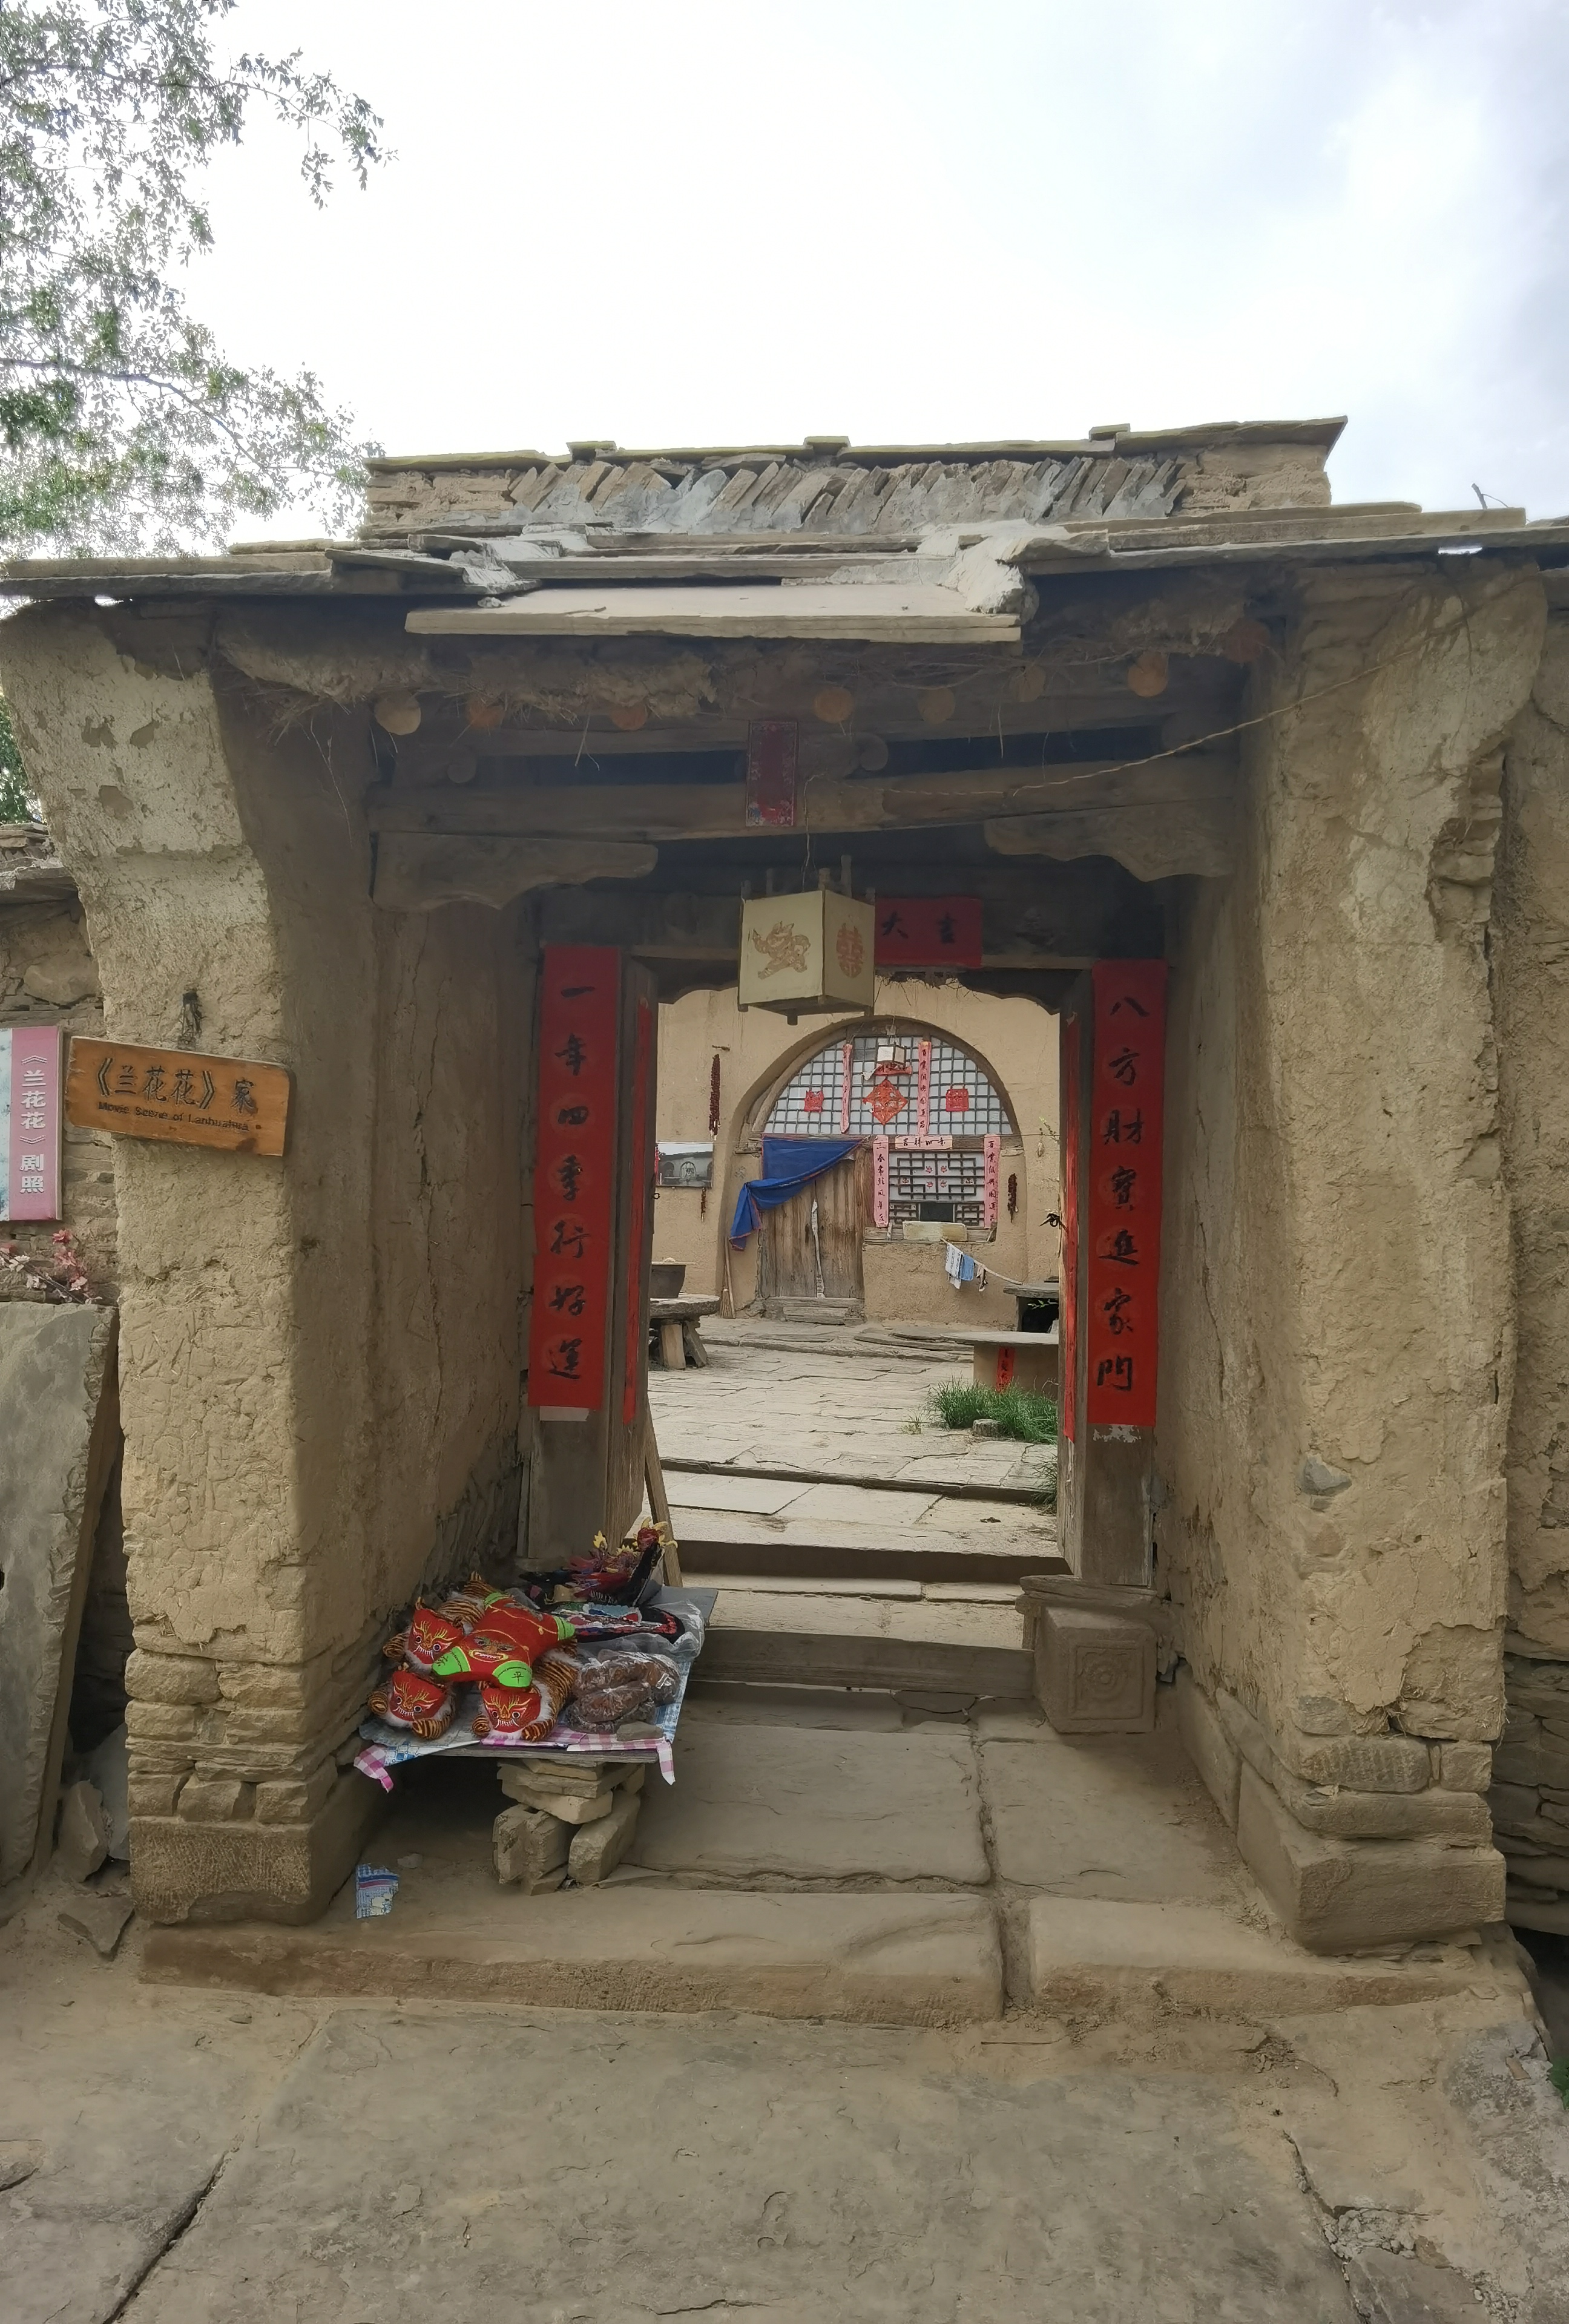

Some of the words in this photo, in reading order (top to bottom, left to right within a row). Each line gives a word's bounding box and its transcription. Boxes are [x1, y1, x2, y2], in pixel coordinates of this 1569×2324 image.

[98, 1101, 130, 1115] Movie
[135, 1106, 168, 1120] Scene
[173, 1111, 185, 1122] of
[19, 1055, 48, 1193] 《兰花花》剧照
[511, 1671, 524, 1684] 平
